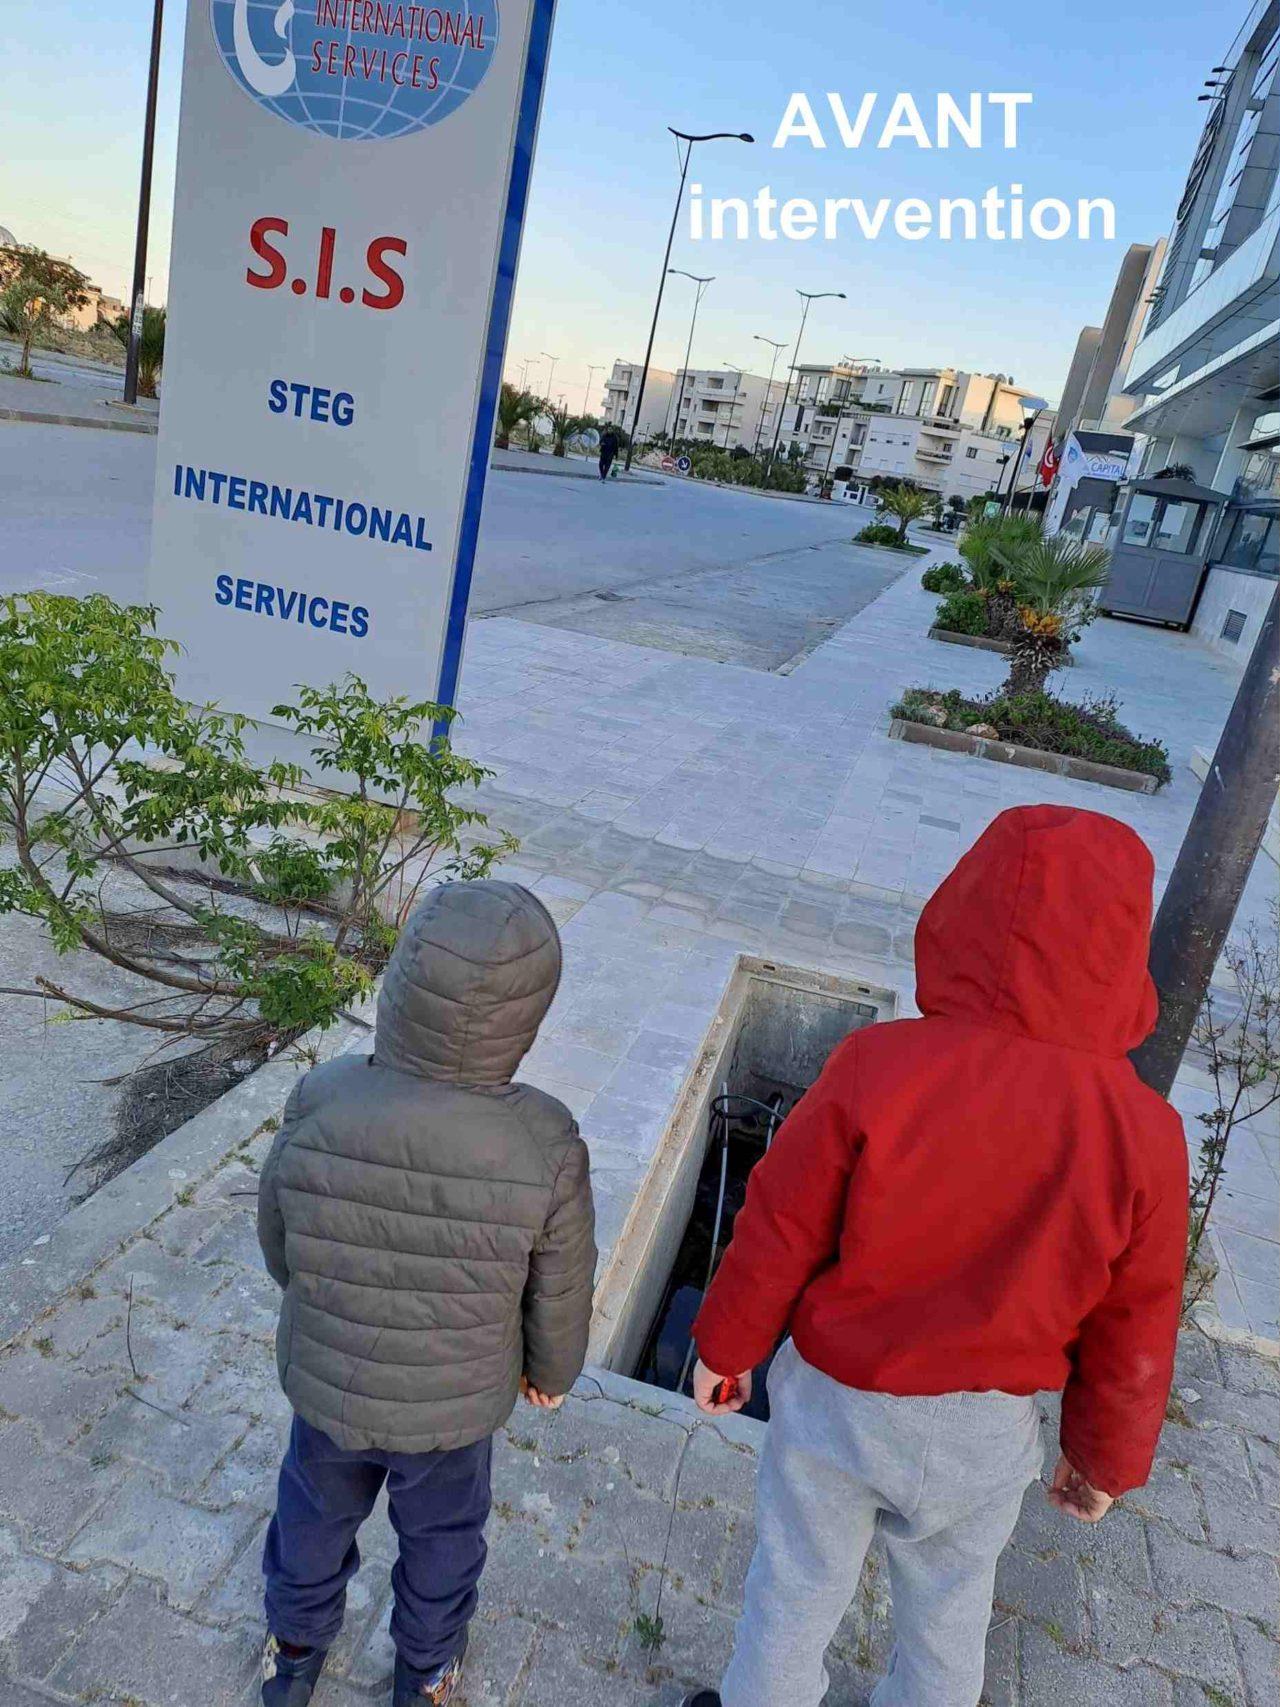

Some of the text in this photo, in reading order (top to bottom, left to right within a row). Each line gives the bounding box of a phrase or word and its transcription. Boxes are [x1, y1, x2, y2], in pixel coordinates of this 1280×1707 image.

[314, 0, 485, 49] INTERNATIONAL
[311, 40, 440, 90] SERVICES
[246, 217, 407, 310] S.I.S
[267, 379, 355, 427] STEG
[173, 464, 433, 552] INTERNATIONAL
[215, 574, 370, 638] SERVICES
